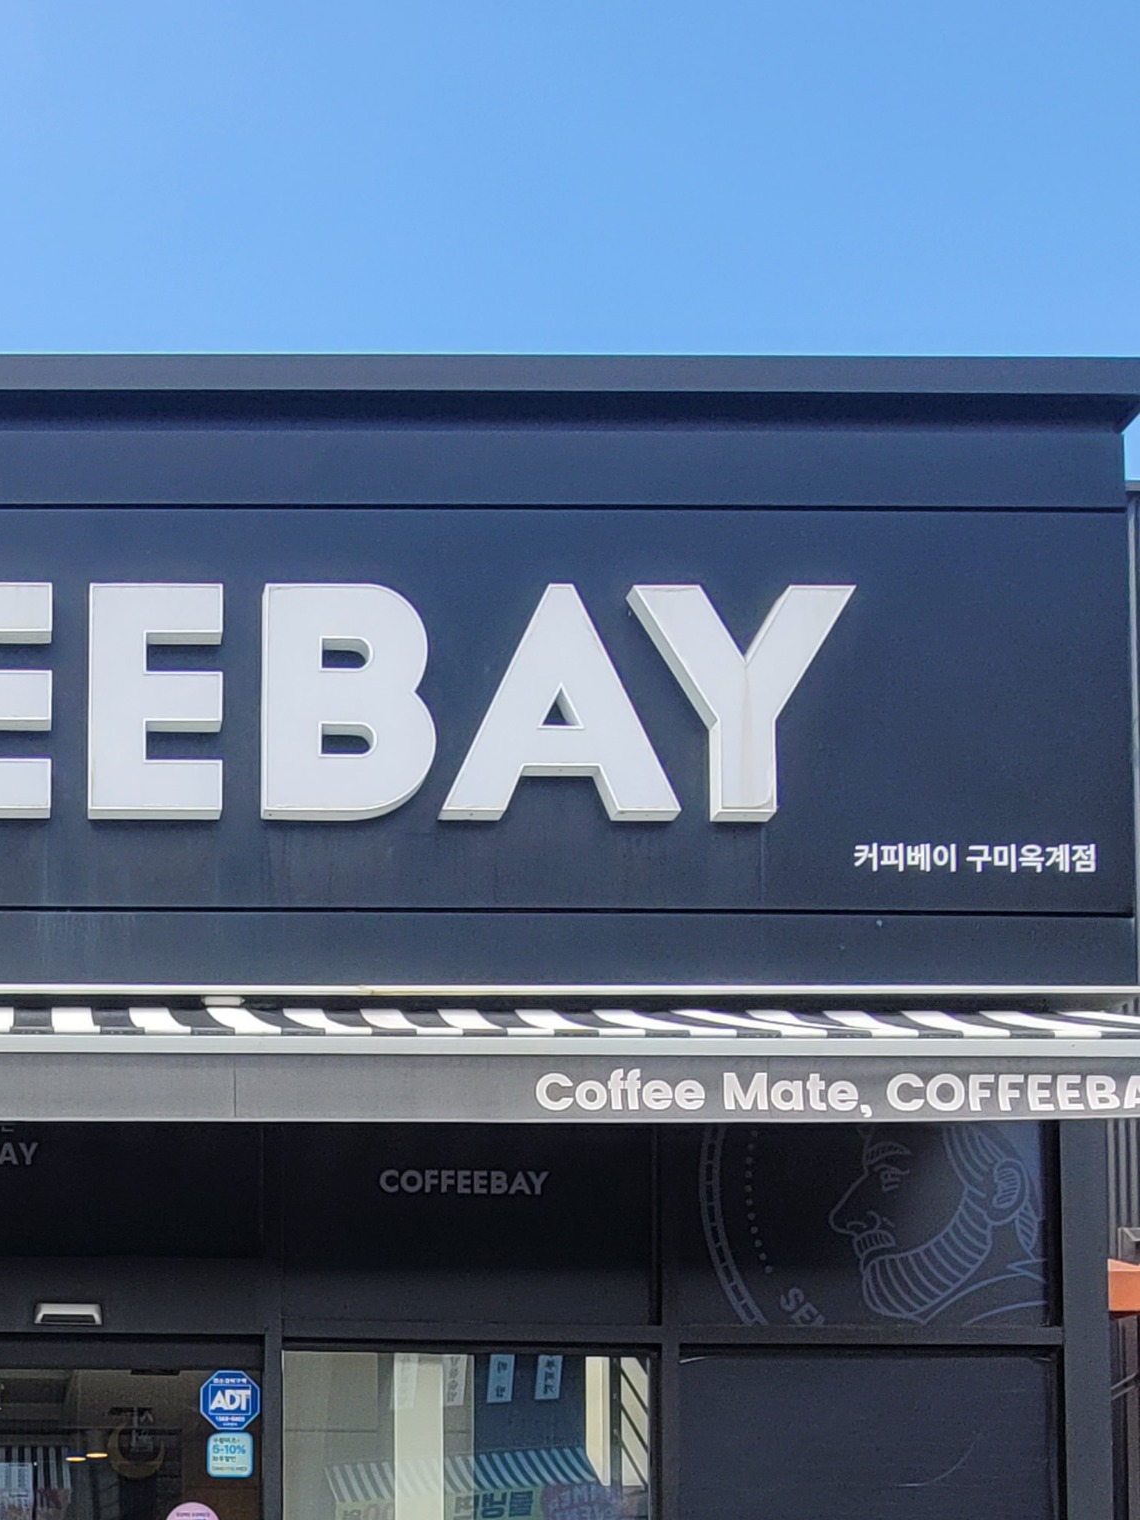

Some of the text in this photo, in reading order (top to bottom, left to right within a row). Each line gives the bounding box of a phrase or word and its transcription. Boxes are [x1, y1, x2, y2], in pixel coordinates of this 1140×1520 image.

[853, 842, 1098, 873] 커피베이 구미옥계점
[535, 1068, 706, 1112] Coffee
[722, 1071, 873, 1118] Mate,
[378, 1169, 550, 1197] COFFEEBAY
[209, 1389, 252, 1412] ADT
[212, 1444, 247, 1455] 5-10%
